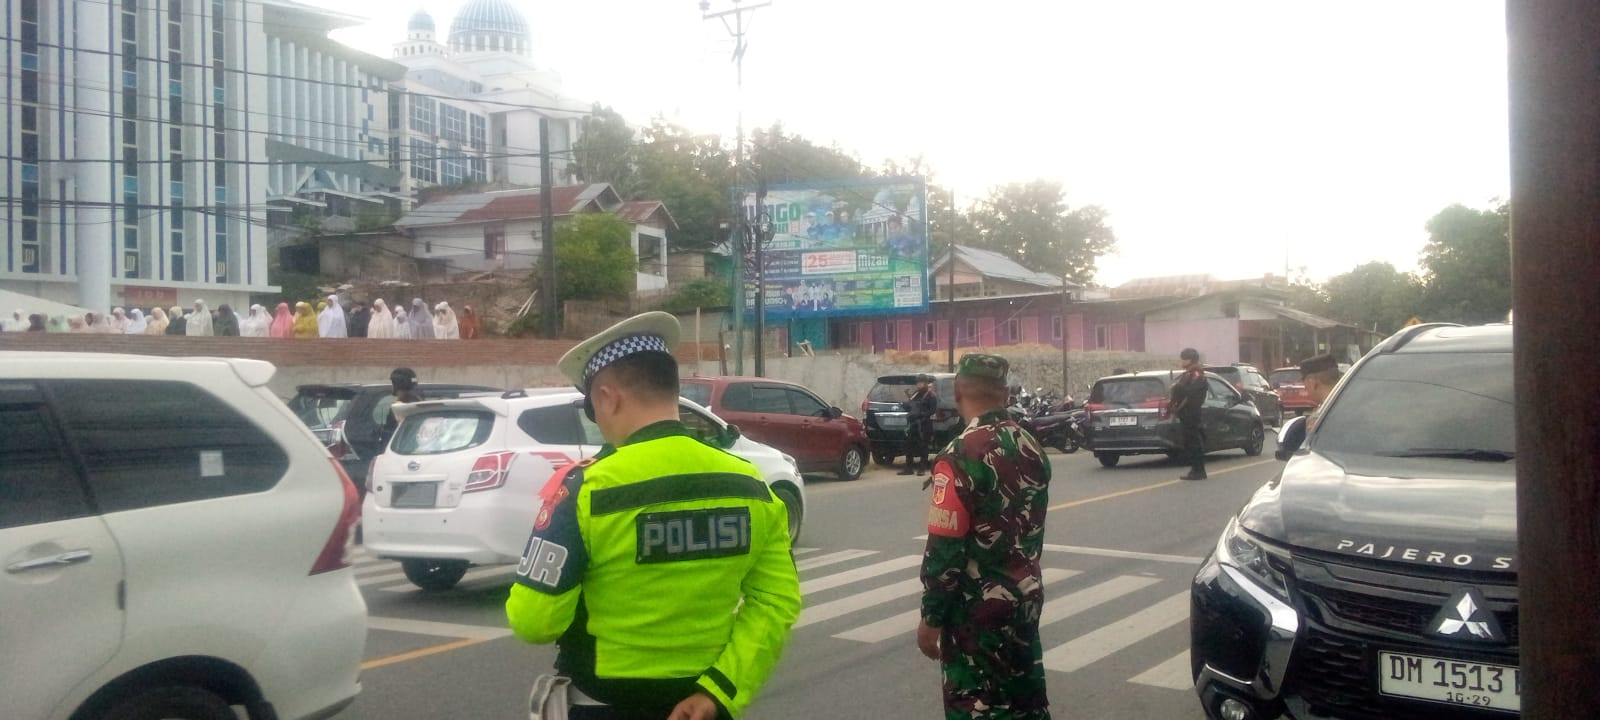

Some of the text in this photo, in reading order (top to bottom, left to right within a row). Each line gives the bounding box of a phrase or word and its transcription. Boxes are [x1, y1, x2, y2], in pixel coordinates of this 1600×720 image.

[641, 515, 748, 557] POLISI
[1337, 539, 1473, 566] PAJERO
[1389, 655, 1423, 683] DM
[1433, 661, 1503, 693] 1513
